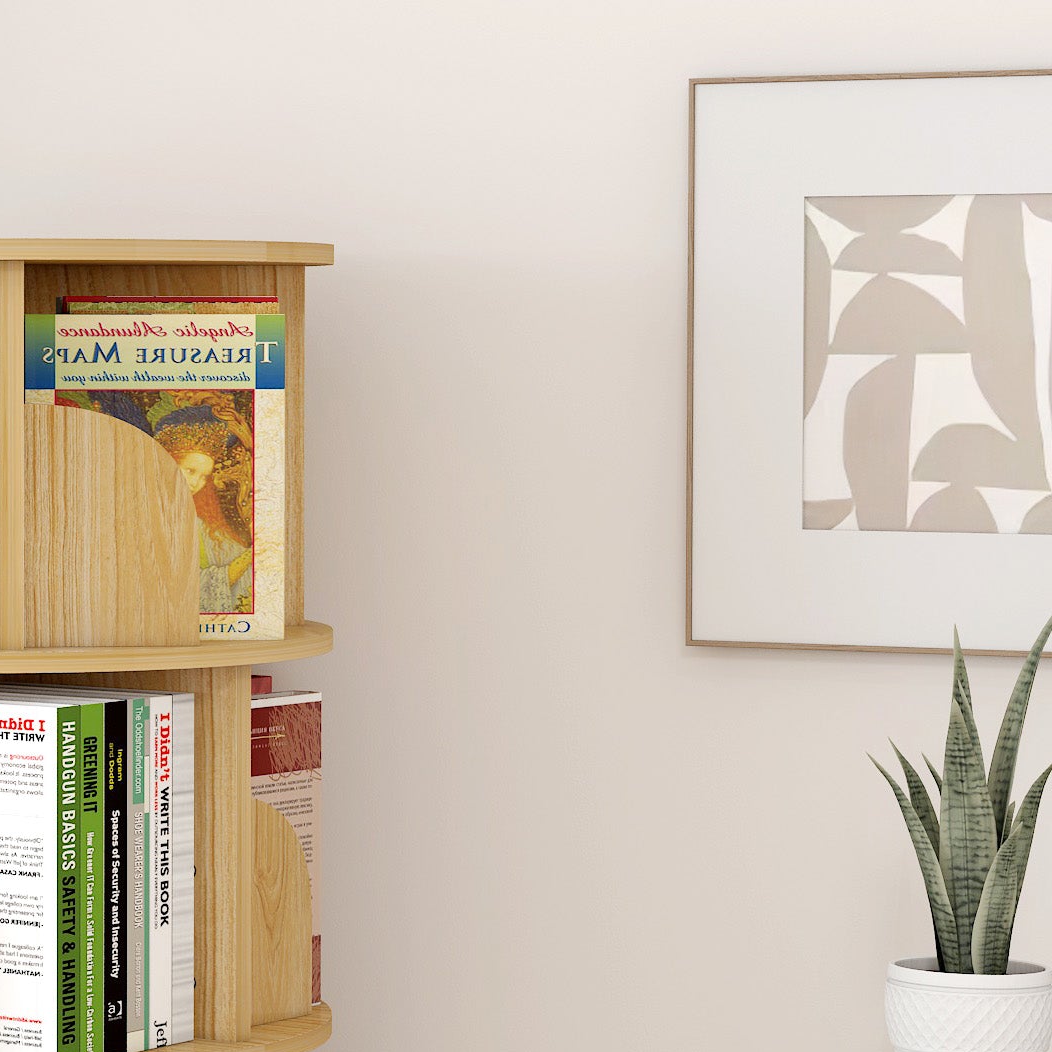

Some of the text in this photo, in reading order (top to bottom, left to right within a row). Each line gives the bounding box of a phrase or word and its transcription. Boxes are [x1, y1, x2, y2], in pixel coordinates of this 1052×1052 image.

[84, 736, 97, 813] GREENING IT
[135, 723, 143, 794] Oddshoefinder.com
[160, 713, 170, 927] I Didn't WRITE THIS BOOK
[62, 721, 76, 1045] HANDGUN BASICS SAFETY & HANDLING
[110, 810, 120, 978] Spaces of Security and Insecurity
[134, 812, 143, 928] SHOE WEARER'S HANDBOOK
